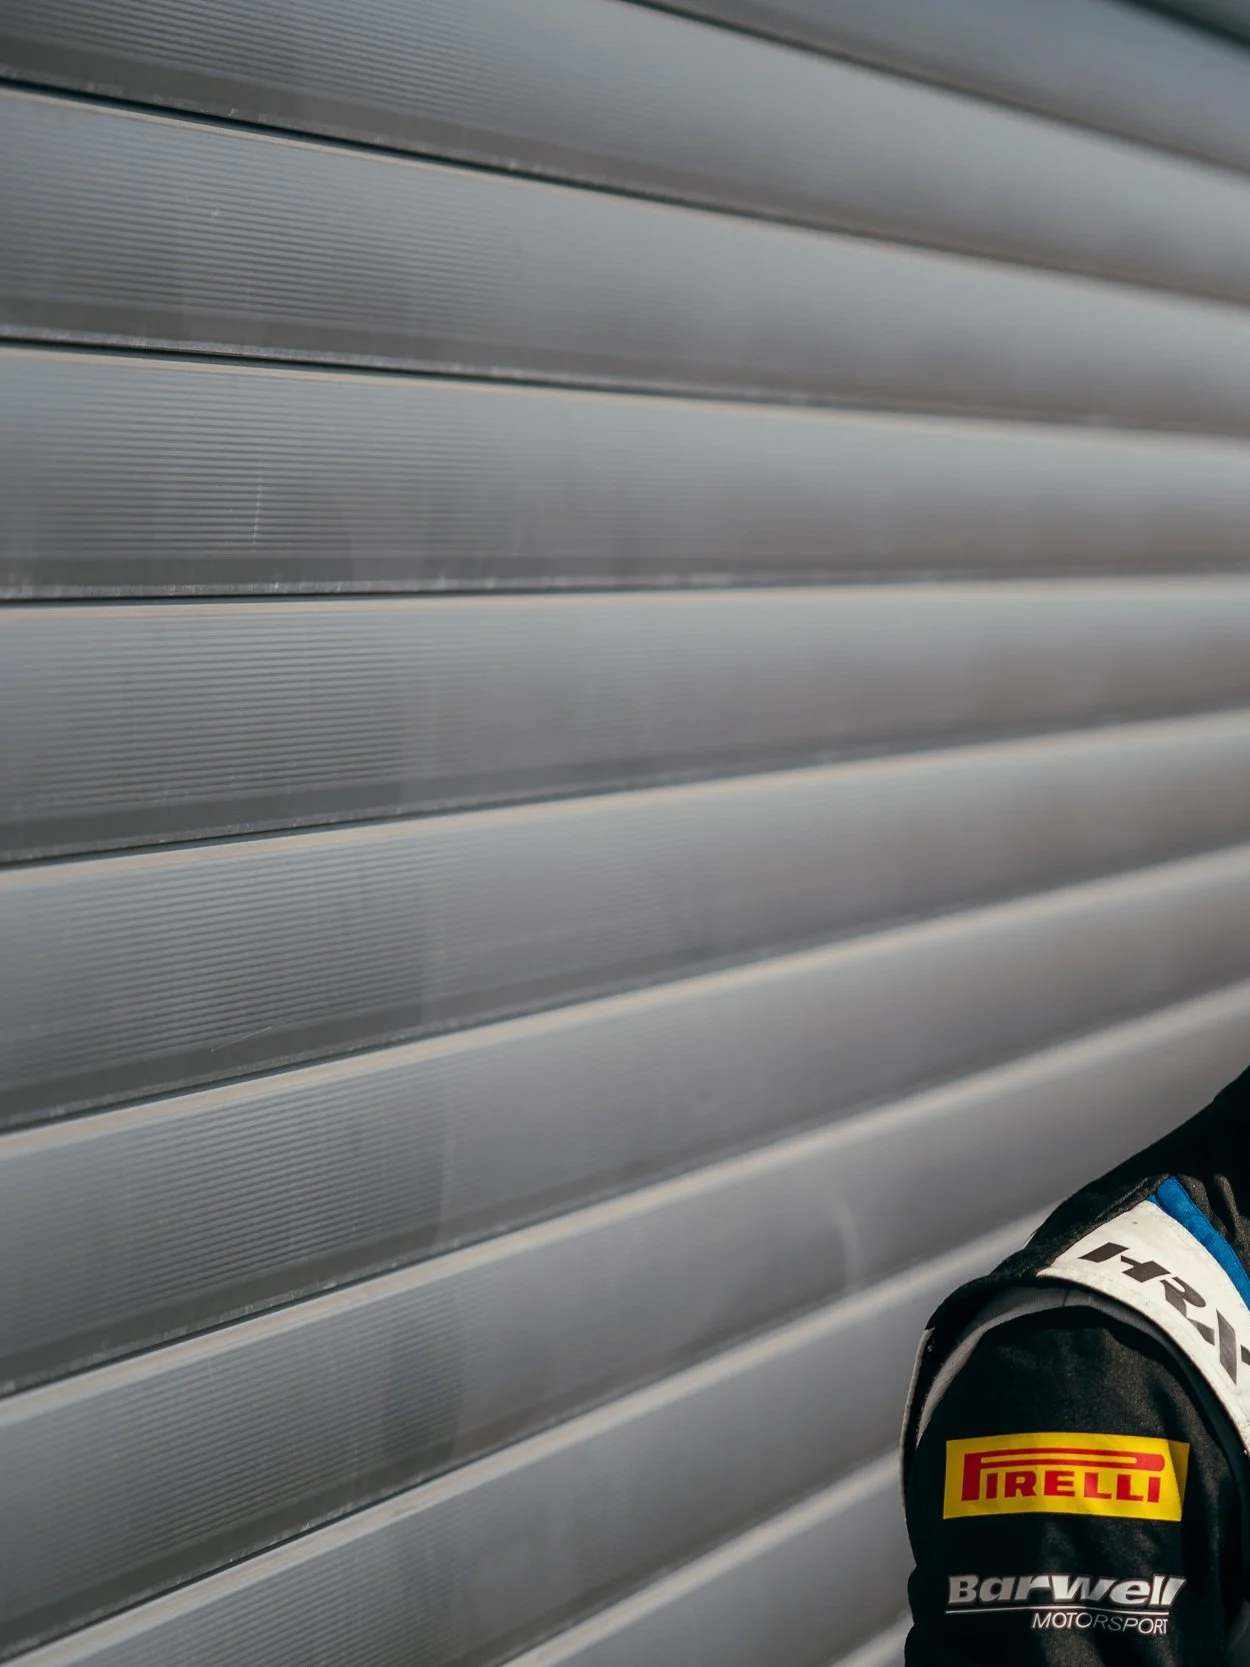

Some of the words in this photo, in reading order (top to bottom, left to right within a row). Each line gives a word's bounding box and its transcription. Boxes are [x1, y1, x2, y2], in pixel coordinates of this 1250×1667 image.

[961, 1447, 1165, 1503] PIRELLI
[948, 1573, 1186, 1606] Barwell
[1031, 1611, 1168, 1635] MOTORSPORT
